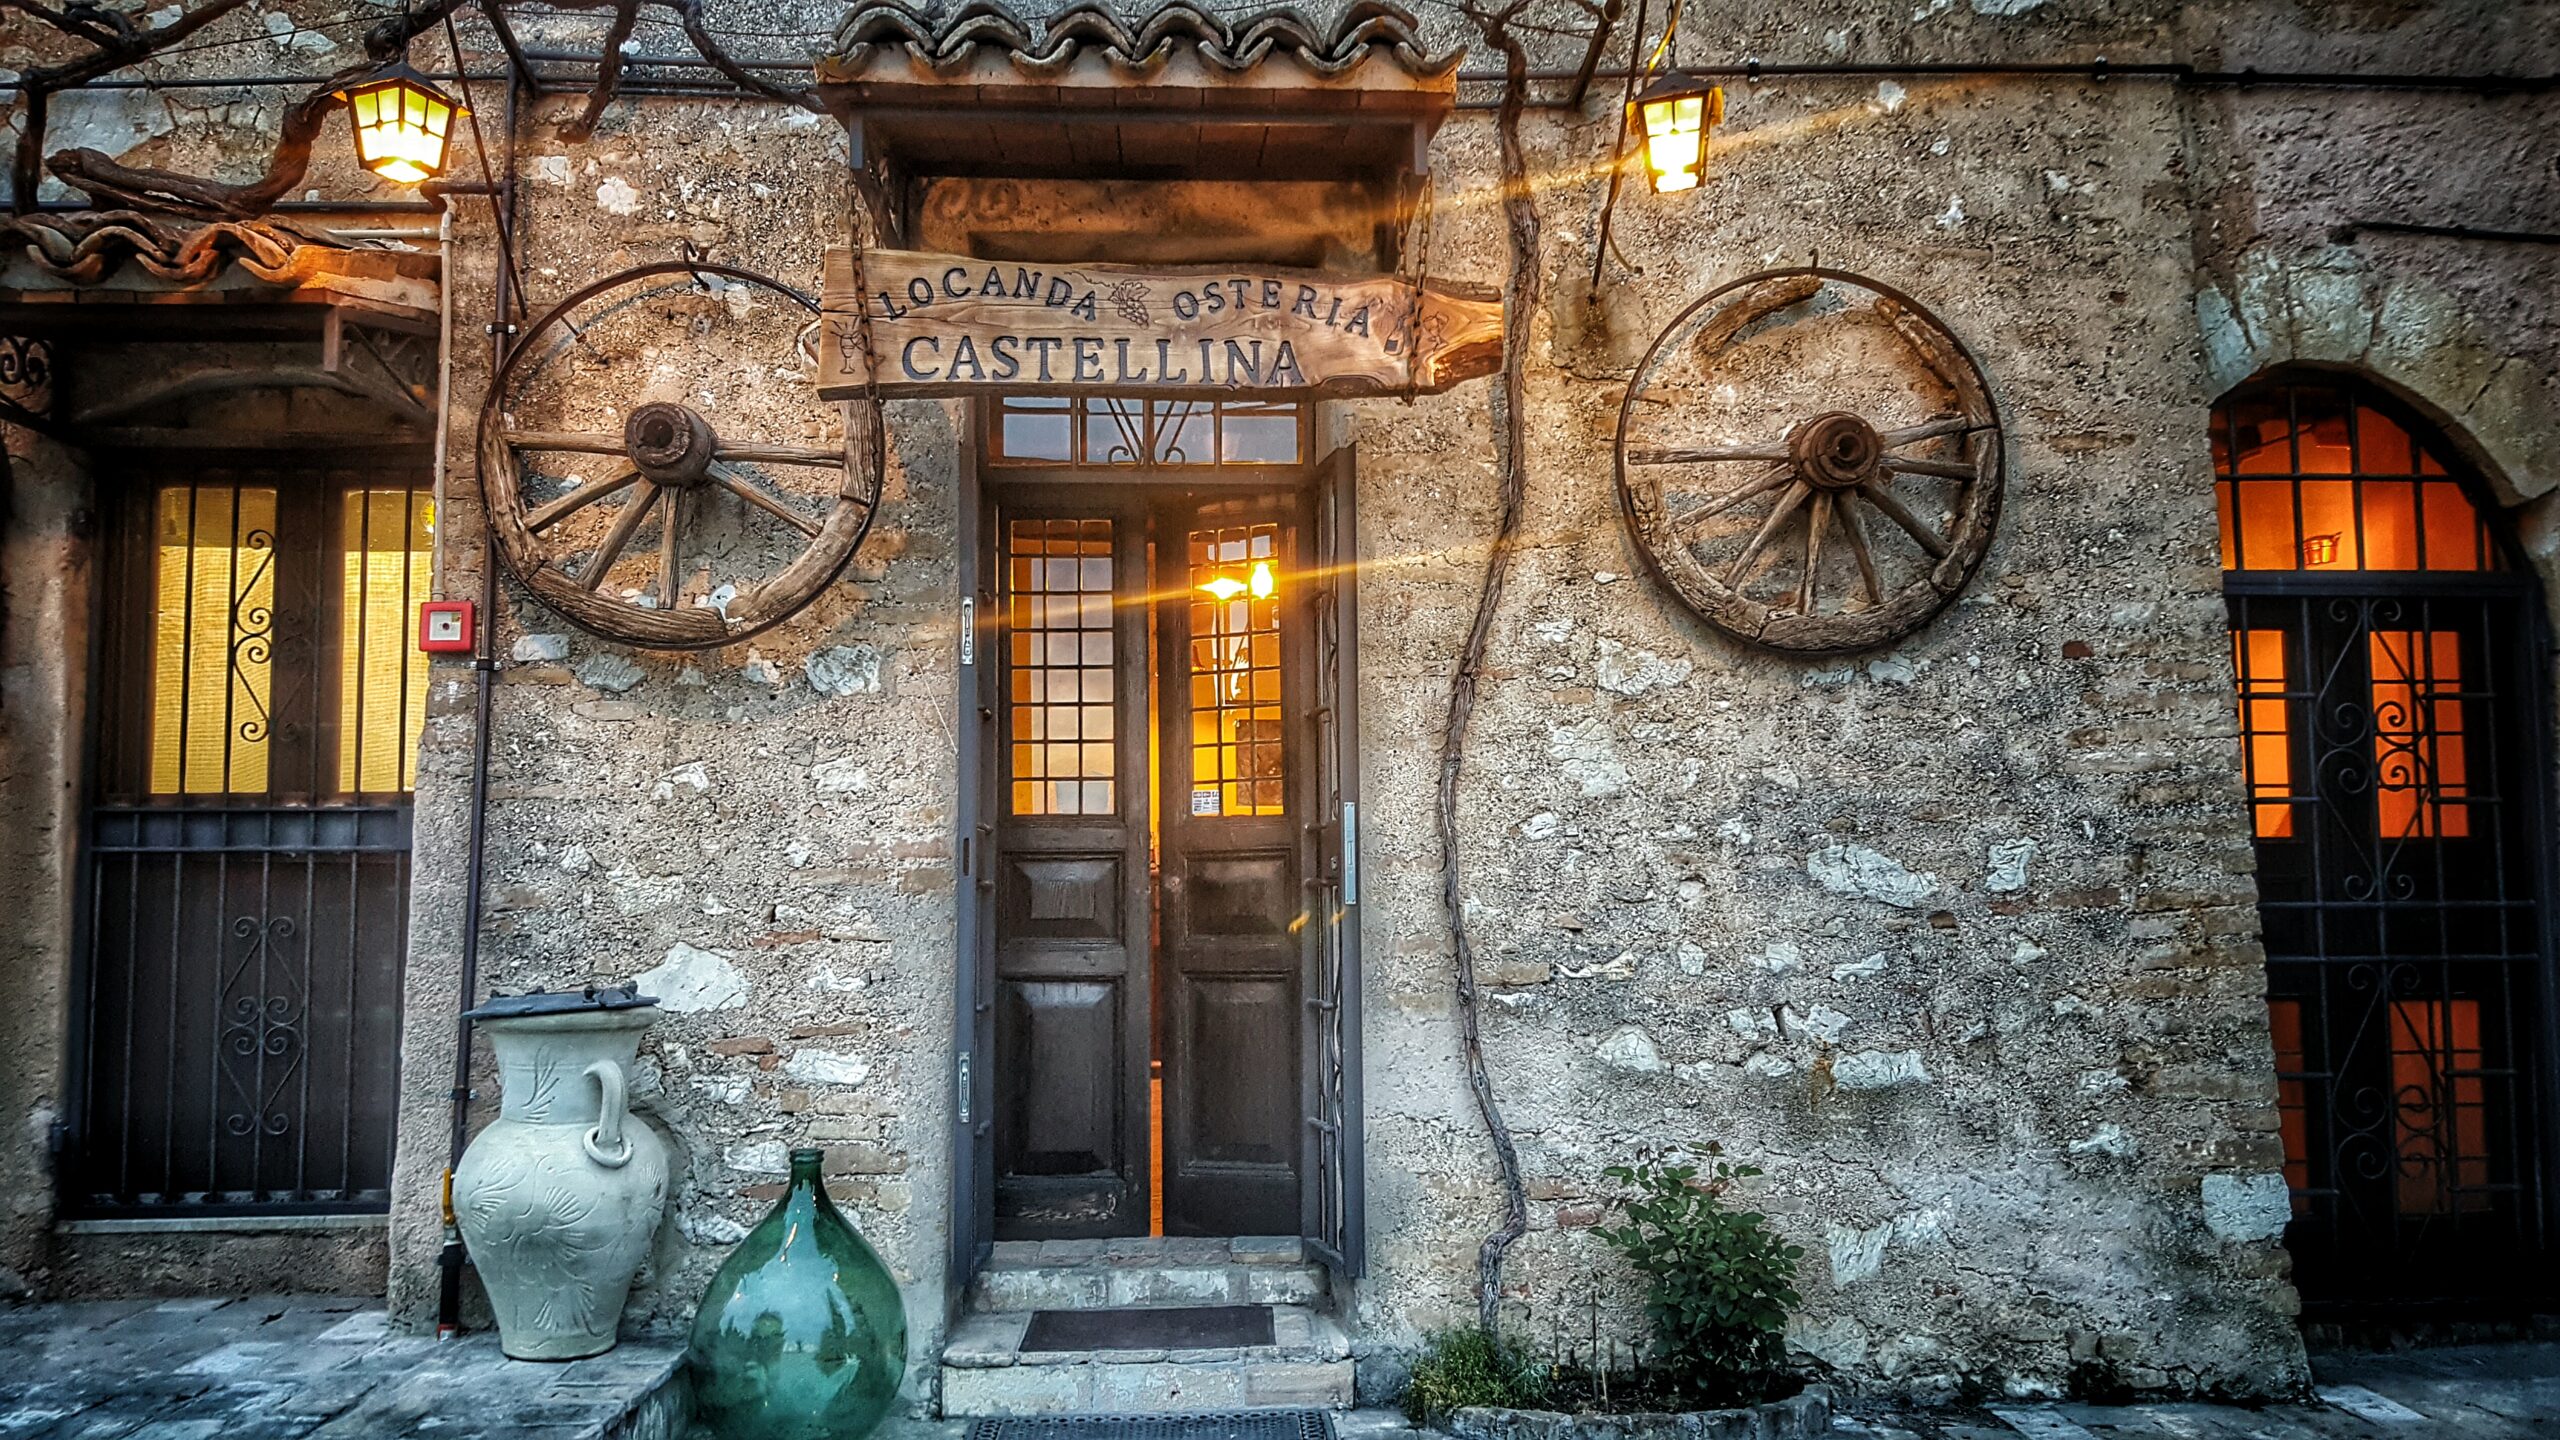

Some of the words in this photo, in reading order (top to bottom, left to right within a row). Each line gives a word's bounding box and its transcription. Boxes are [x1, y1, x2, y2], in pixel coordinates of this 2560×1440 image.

[878, 266, 1097, 322] LOCANDA
[1172, 279, 1369, 338] OSTERIA
[902, 335, 1306, 385] CASTELLINA
